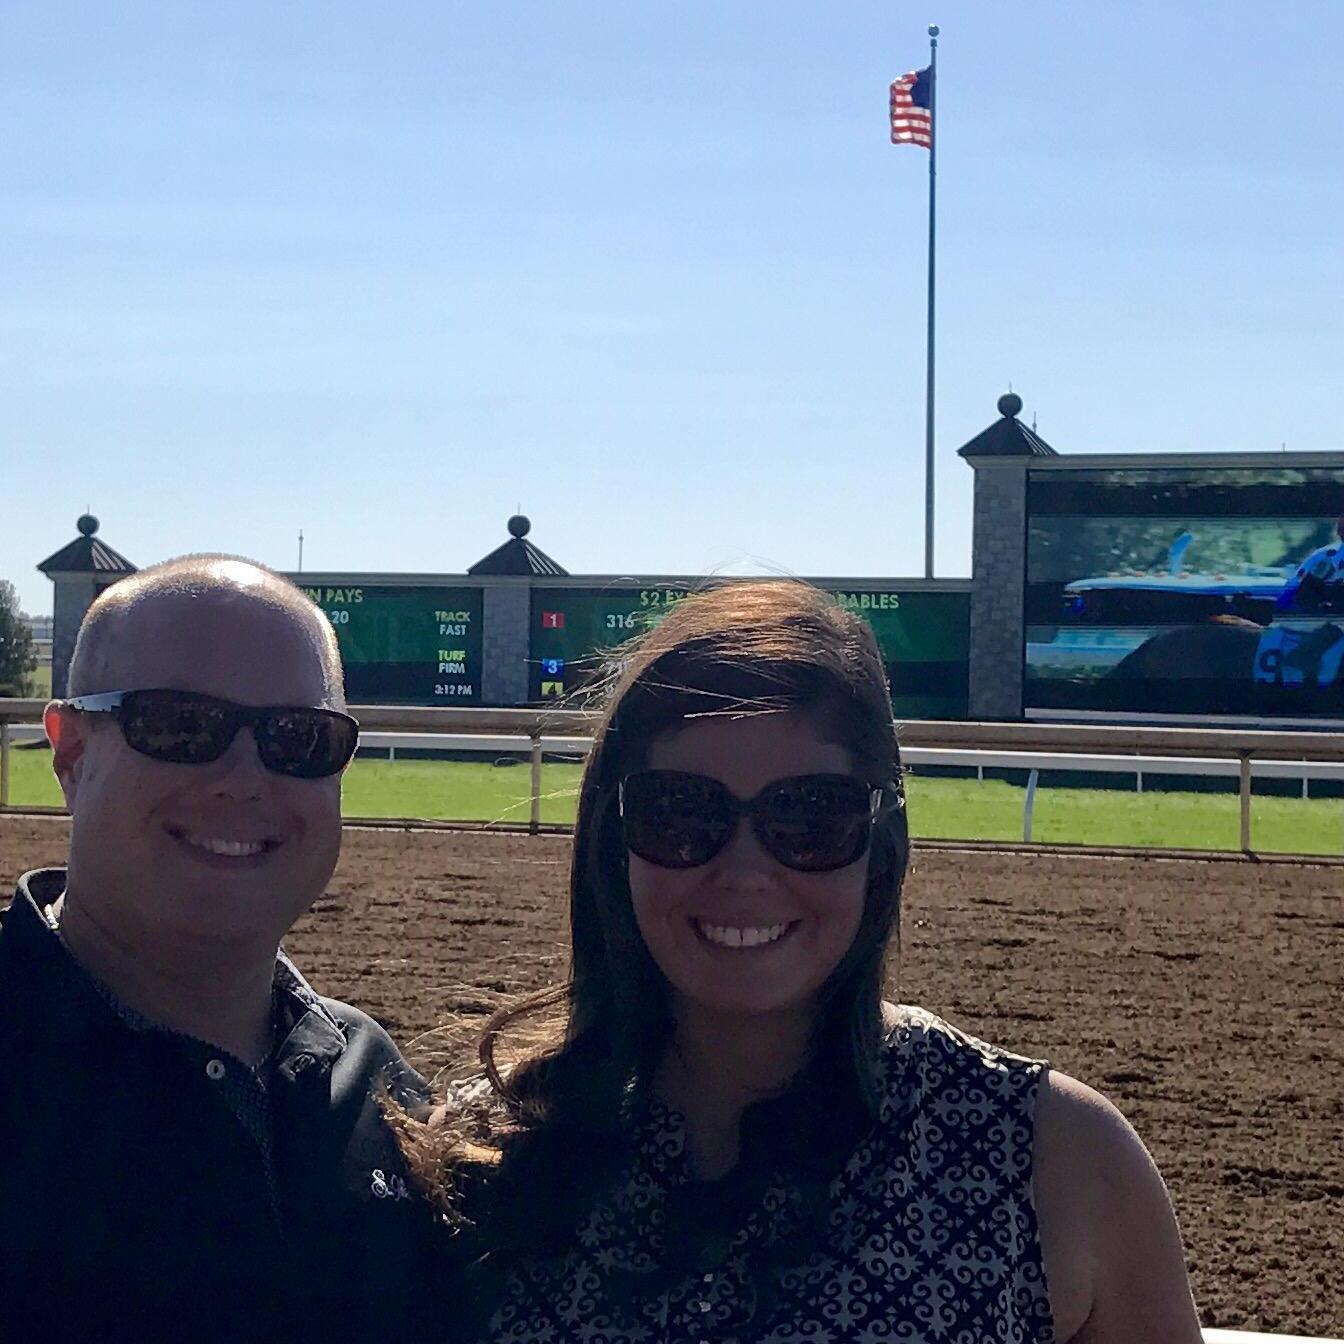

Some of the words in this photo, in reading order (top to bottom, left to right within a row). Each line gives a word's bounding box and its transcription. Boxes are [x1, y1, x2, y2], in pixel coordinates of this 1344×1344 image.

[326, 589, 364, 603] PAYS
[837, 593, 899, 609] BABLES
[331, 610, 350, 624] 20
[434, 611, 471, 623] TRACK
[606, 614, 635, 629] 316
[439, 624, 467, 636] FAST
[438, 649, 466, 661] TURF
[438, 662, 465, 674] FIRM
[547, 660, 558, 674] 3
[434, 684, 455, 695] 3:12
[457, 685, 472, 695] PM
